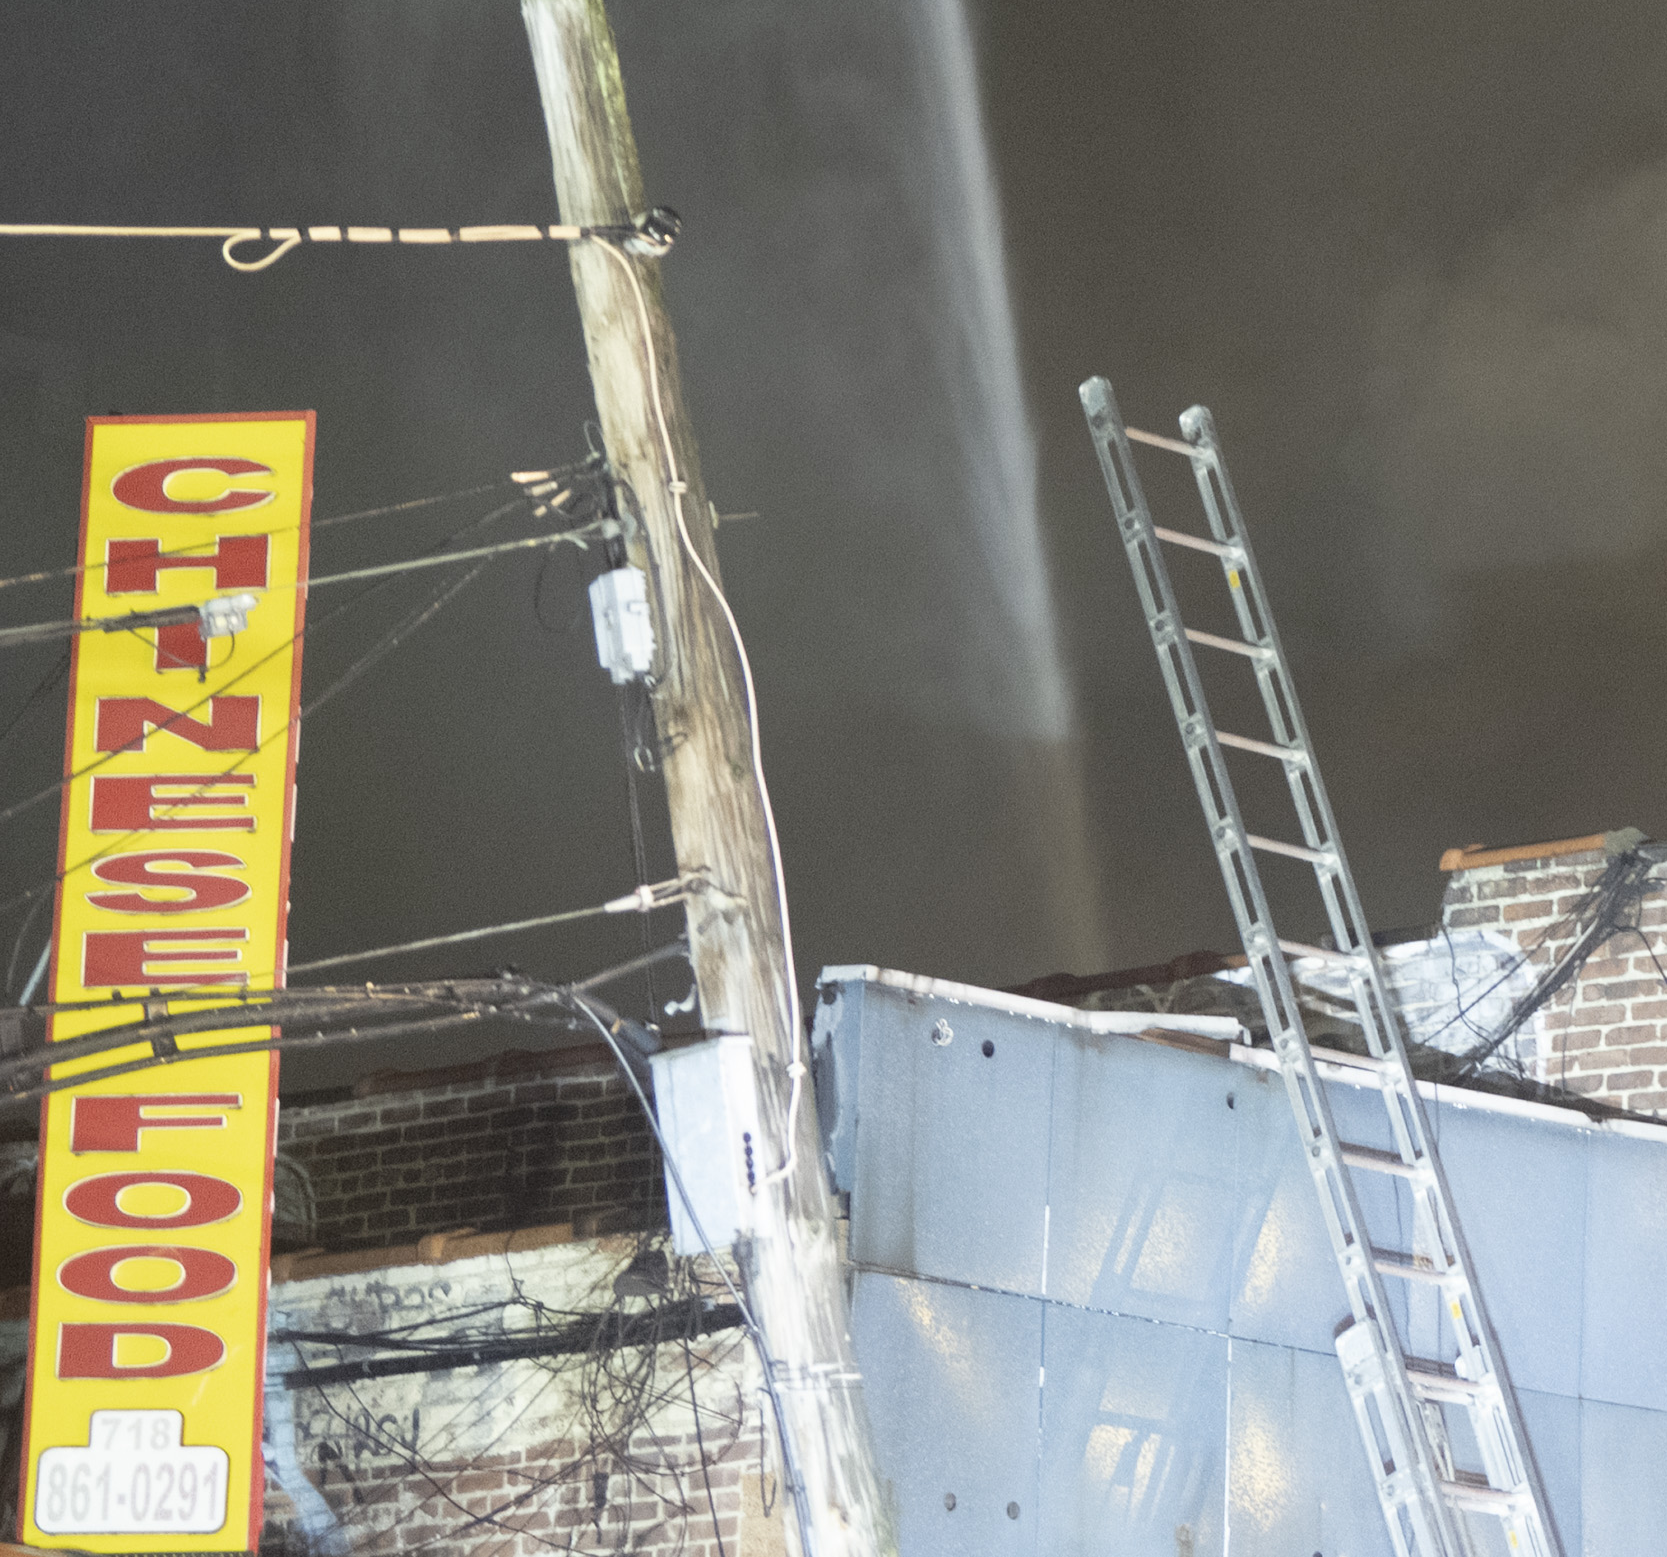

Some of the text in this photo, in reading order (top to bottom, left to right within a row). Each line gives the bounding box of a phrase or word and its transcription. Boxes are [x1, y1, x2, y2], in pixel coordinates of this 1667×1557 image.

[55, 455, 276, 1381] CHINESE FOOD
[101, 1417, 171, 1451] 718
[46, 1461, 220, 1523] 861-0291
